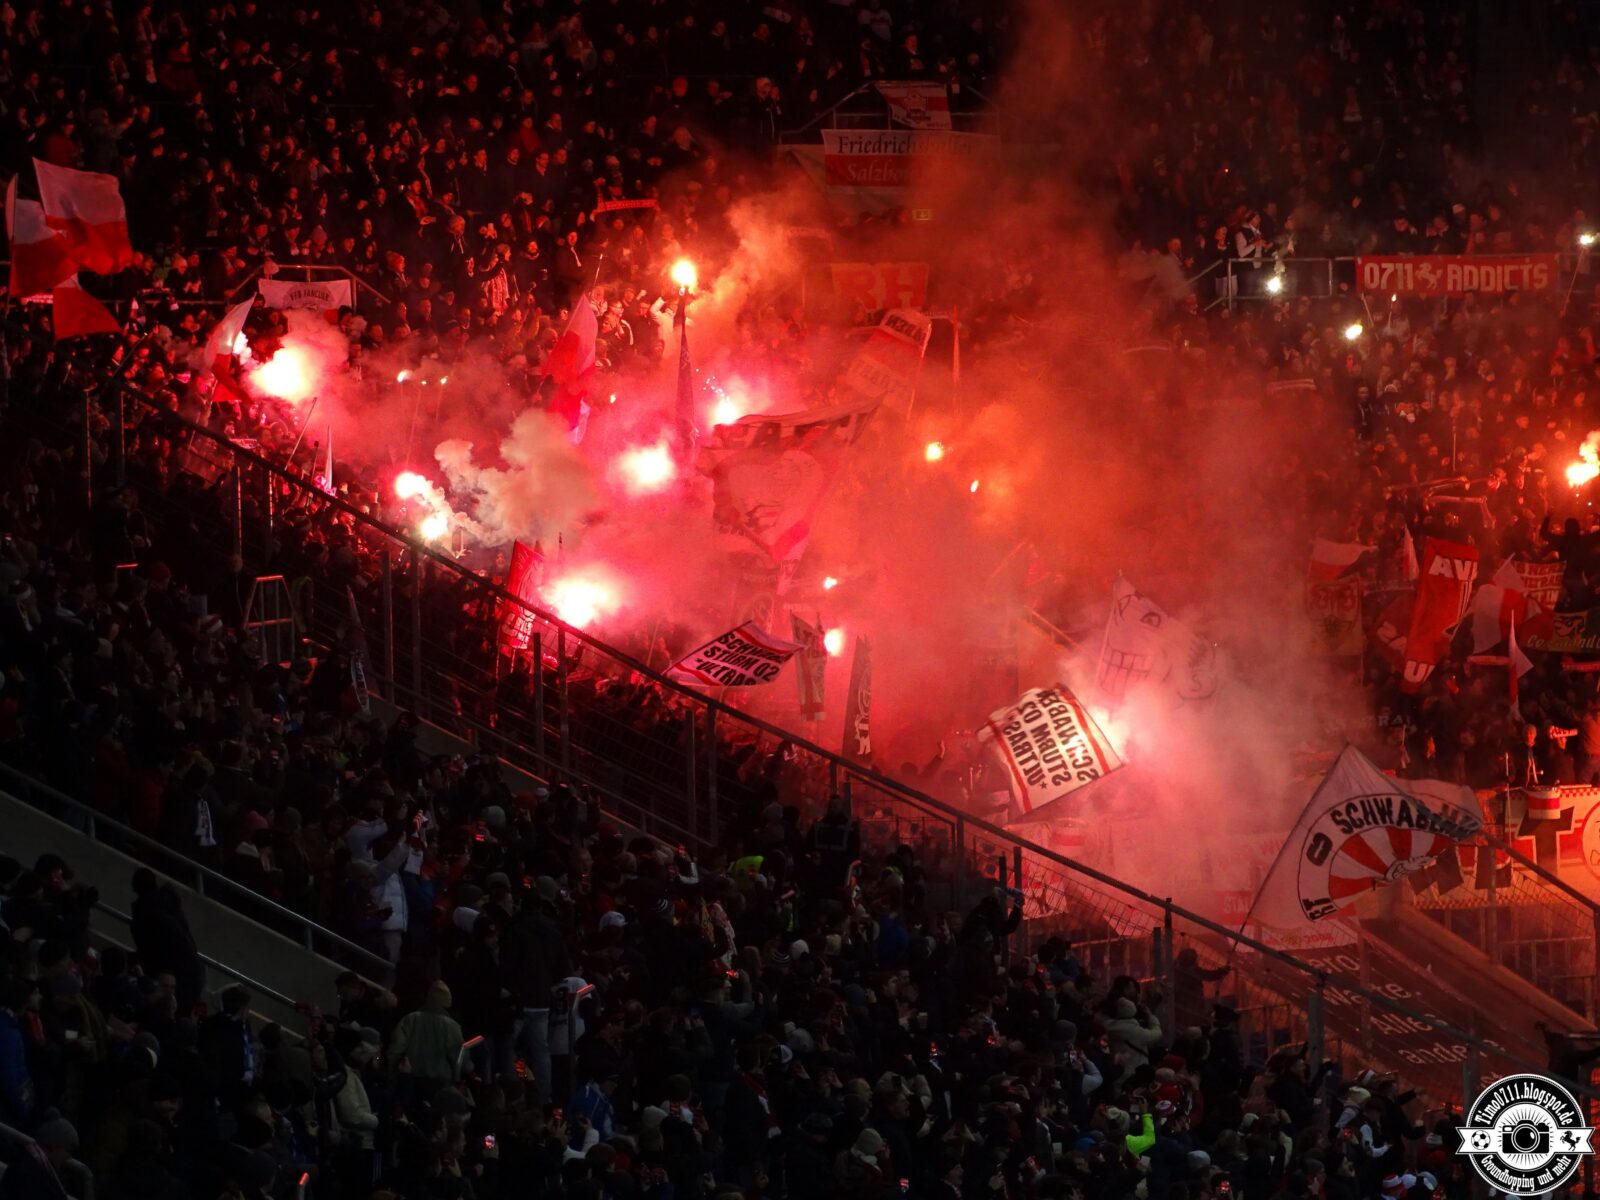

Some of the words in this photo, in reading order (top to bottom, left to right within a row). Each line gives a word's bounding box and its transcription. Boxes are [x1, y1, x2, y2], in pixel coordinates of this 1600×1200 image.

[1364, 262, 1414, 290] 0711
[1447, 262, 1549, 291] ADDICTS
[703, 646, 756, 671] STURM
[752, 662, 780, 683] 02
